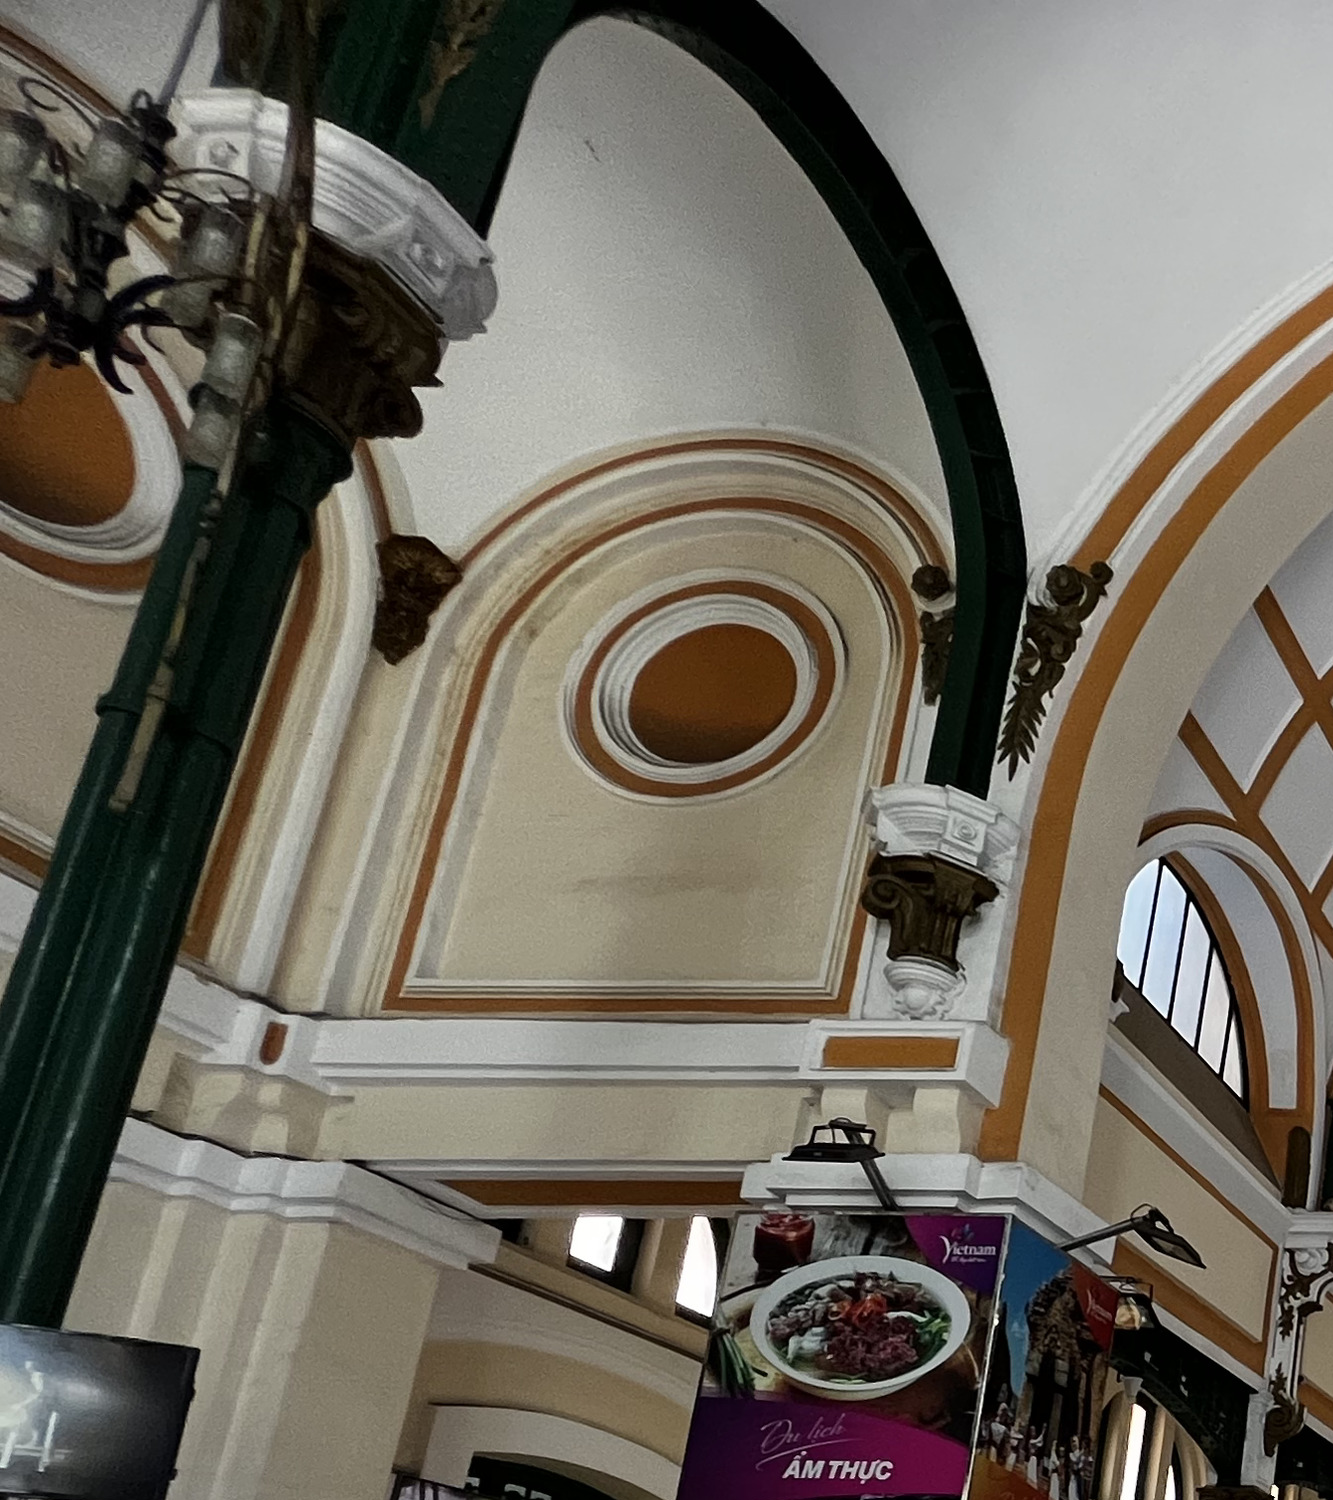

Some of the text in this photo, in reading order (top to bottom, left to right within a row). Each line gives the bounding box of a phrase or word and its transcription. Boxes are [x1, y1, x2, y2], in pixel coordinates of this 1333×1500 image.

[940, 1235, 996, 1264] Vietnam
[761, 1419, 801, 1454] Du
[782, 1451, 894, 1485] ẨM THỰC
